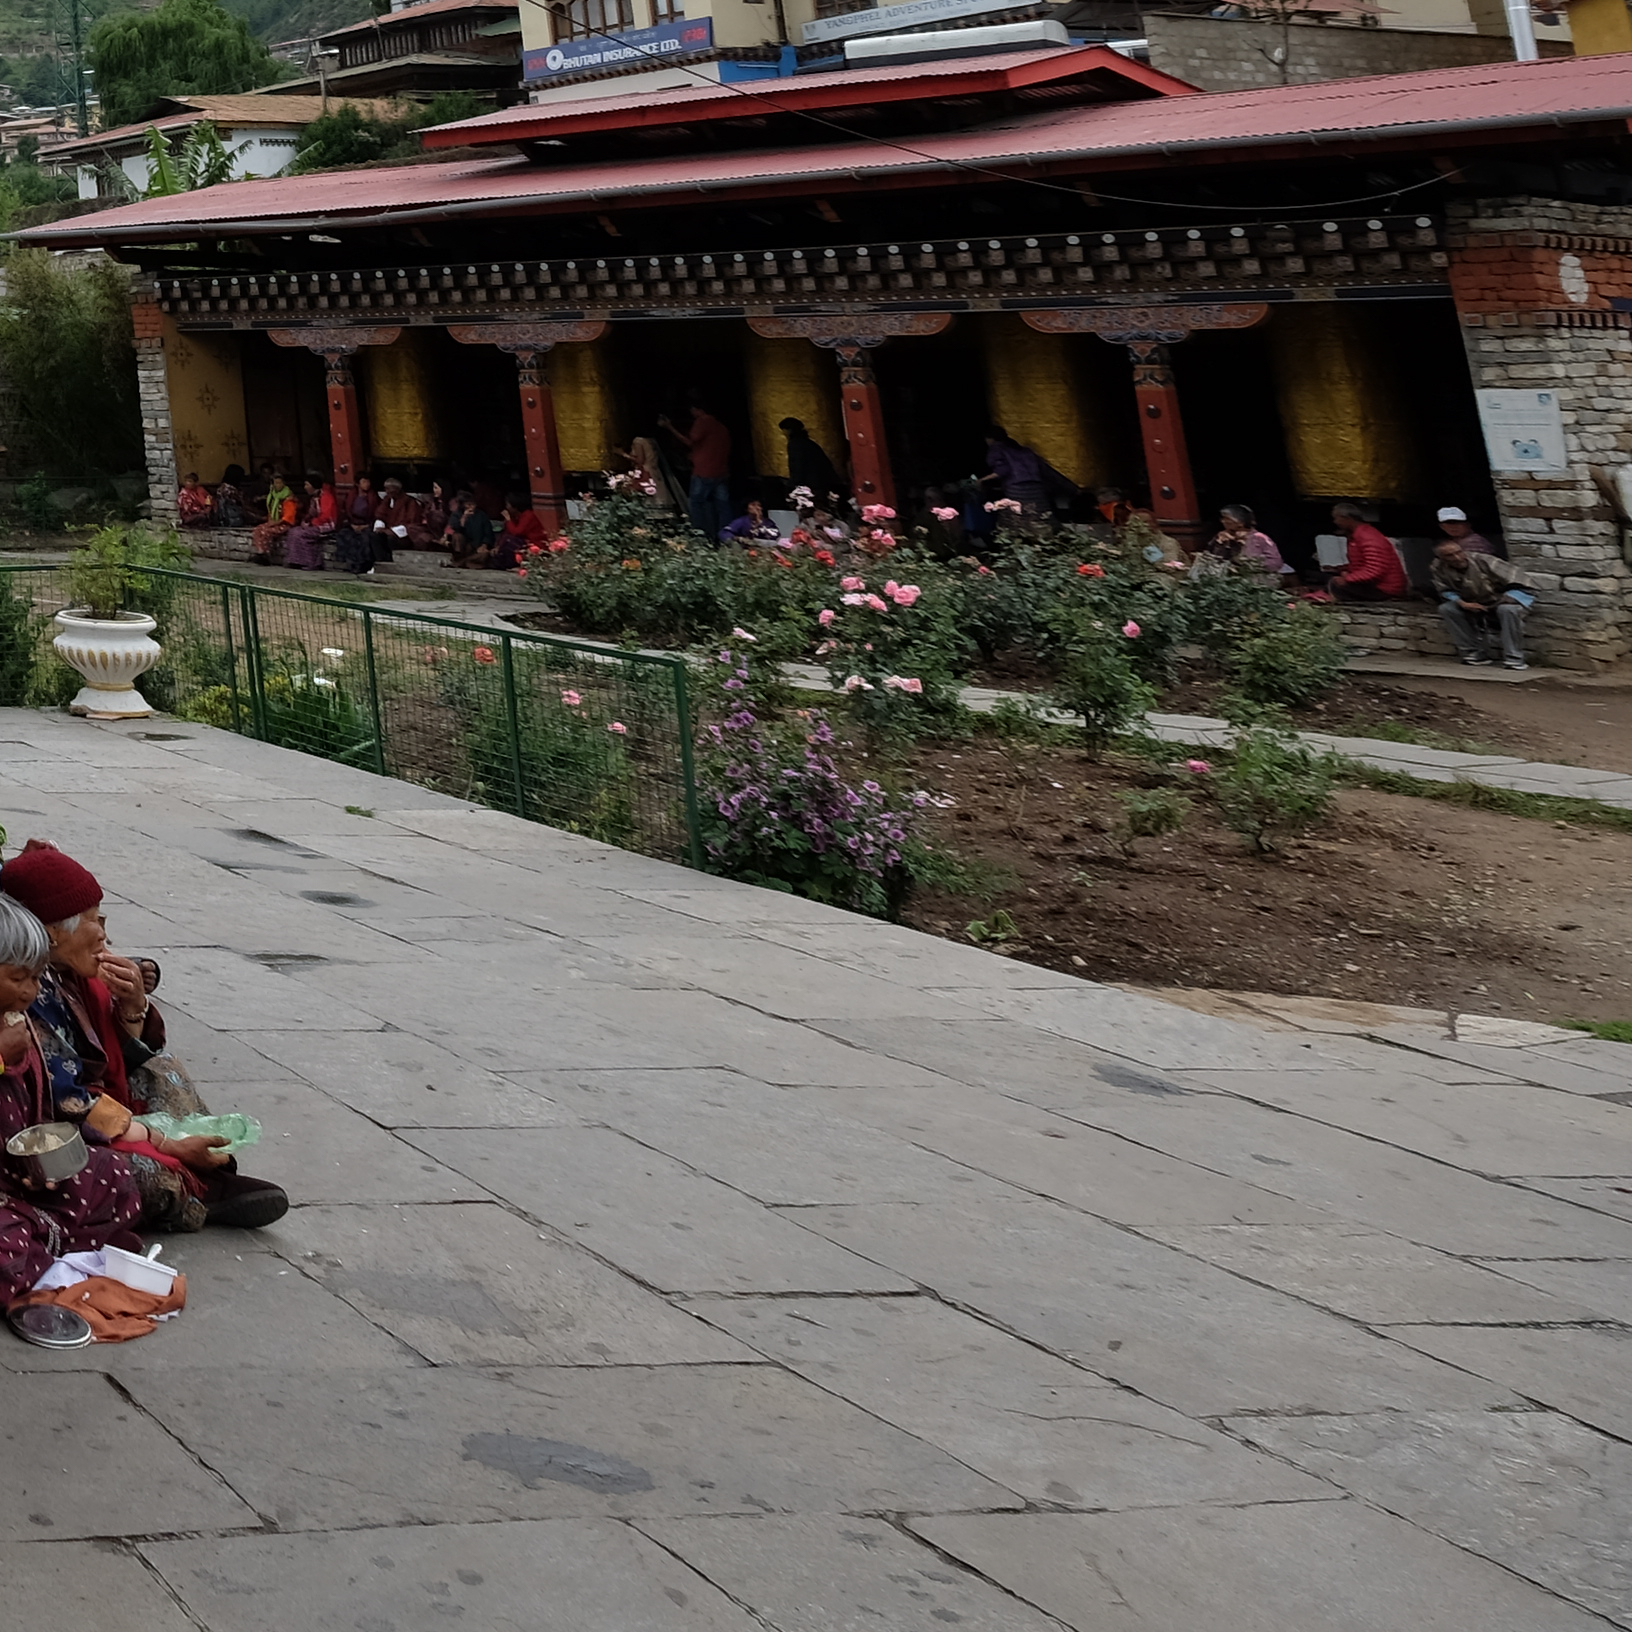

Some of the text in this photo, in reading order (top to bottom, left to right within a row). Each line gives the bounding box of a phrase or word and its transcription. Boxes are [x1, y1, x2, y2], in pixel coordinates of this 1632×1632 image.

[825, 11, 881, 29] YANGPHEL
[562, 52, 602, 69] BHUTAN
[602, 42, 661, 63] INSURANCE
[660, 38, 682, 53] LTD.
